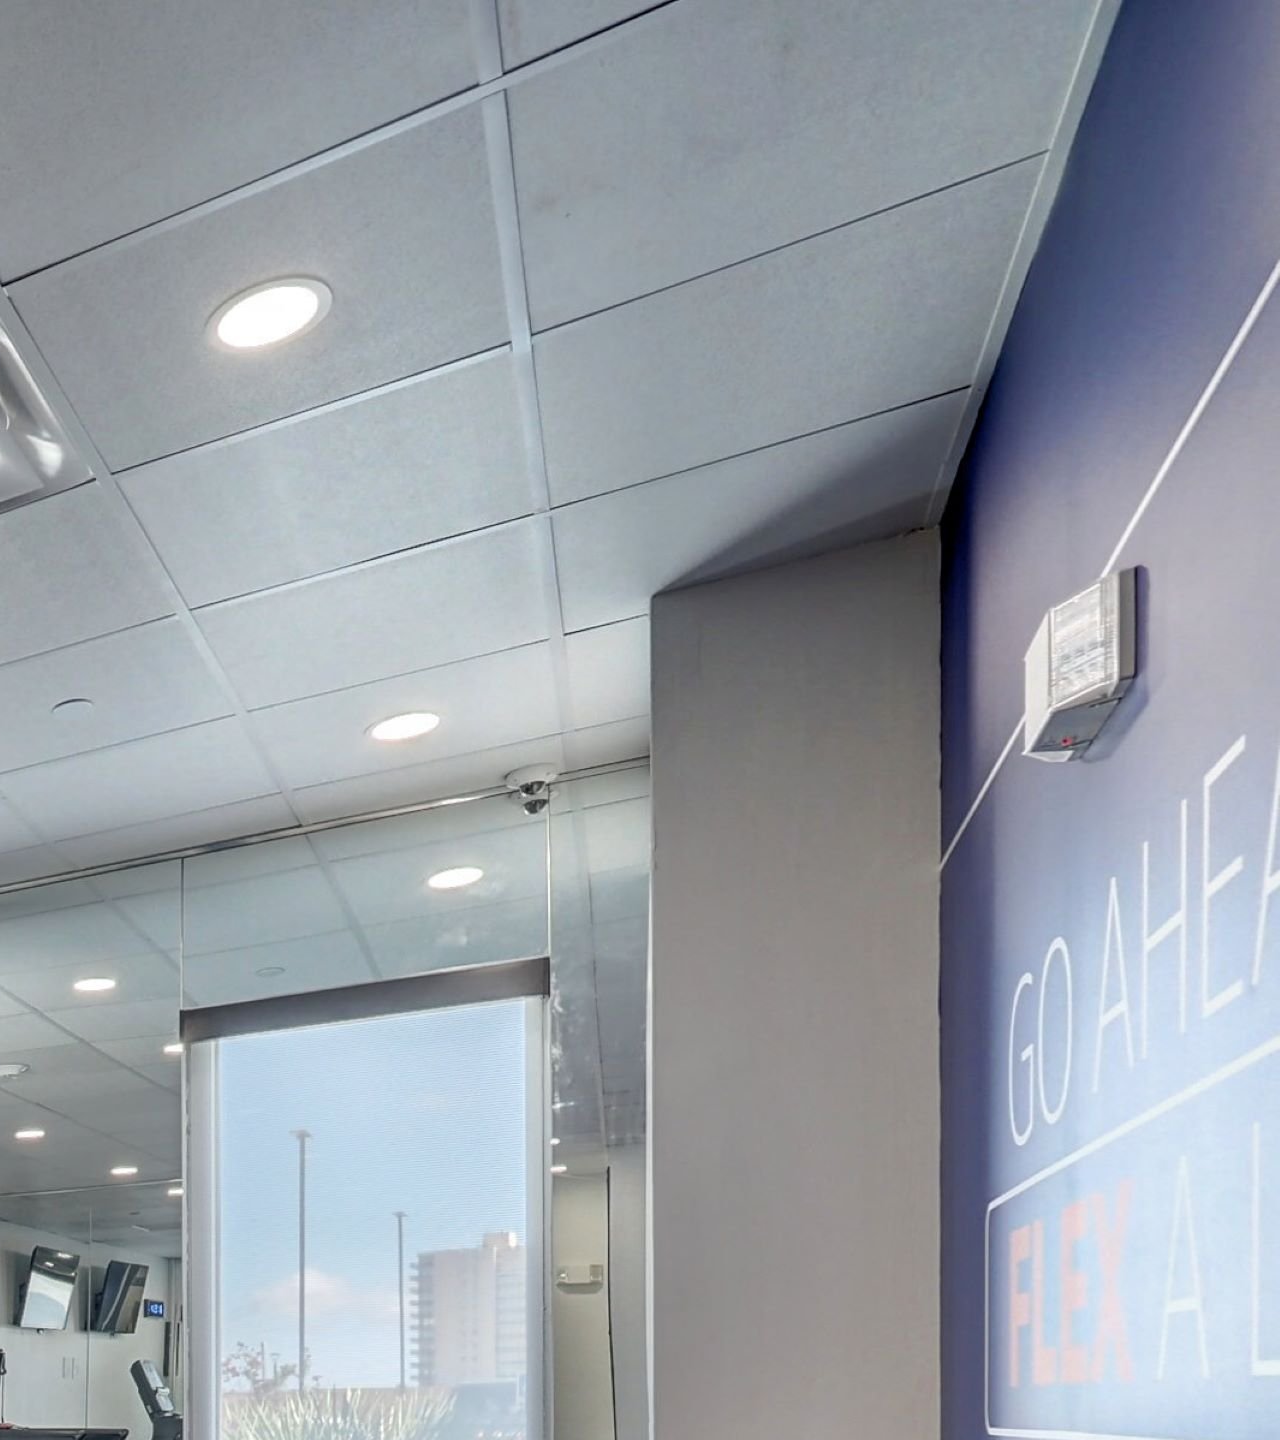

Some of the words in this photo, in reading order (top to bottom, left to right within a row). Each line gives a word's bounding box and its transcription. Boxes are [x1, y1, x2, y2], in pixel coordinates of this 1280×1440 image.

[1008, 936, 1073, 1146] GO
[1008, 1176, 1135, 1388] FLEX
[1156, 1154, 1211, 1382] A
